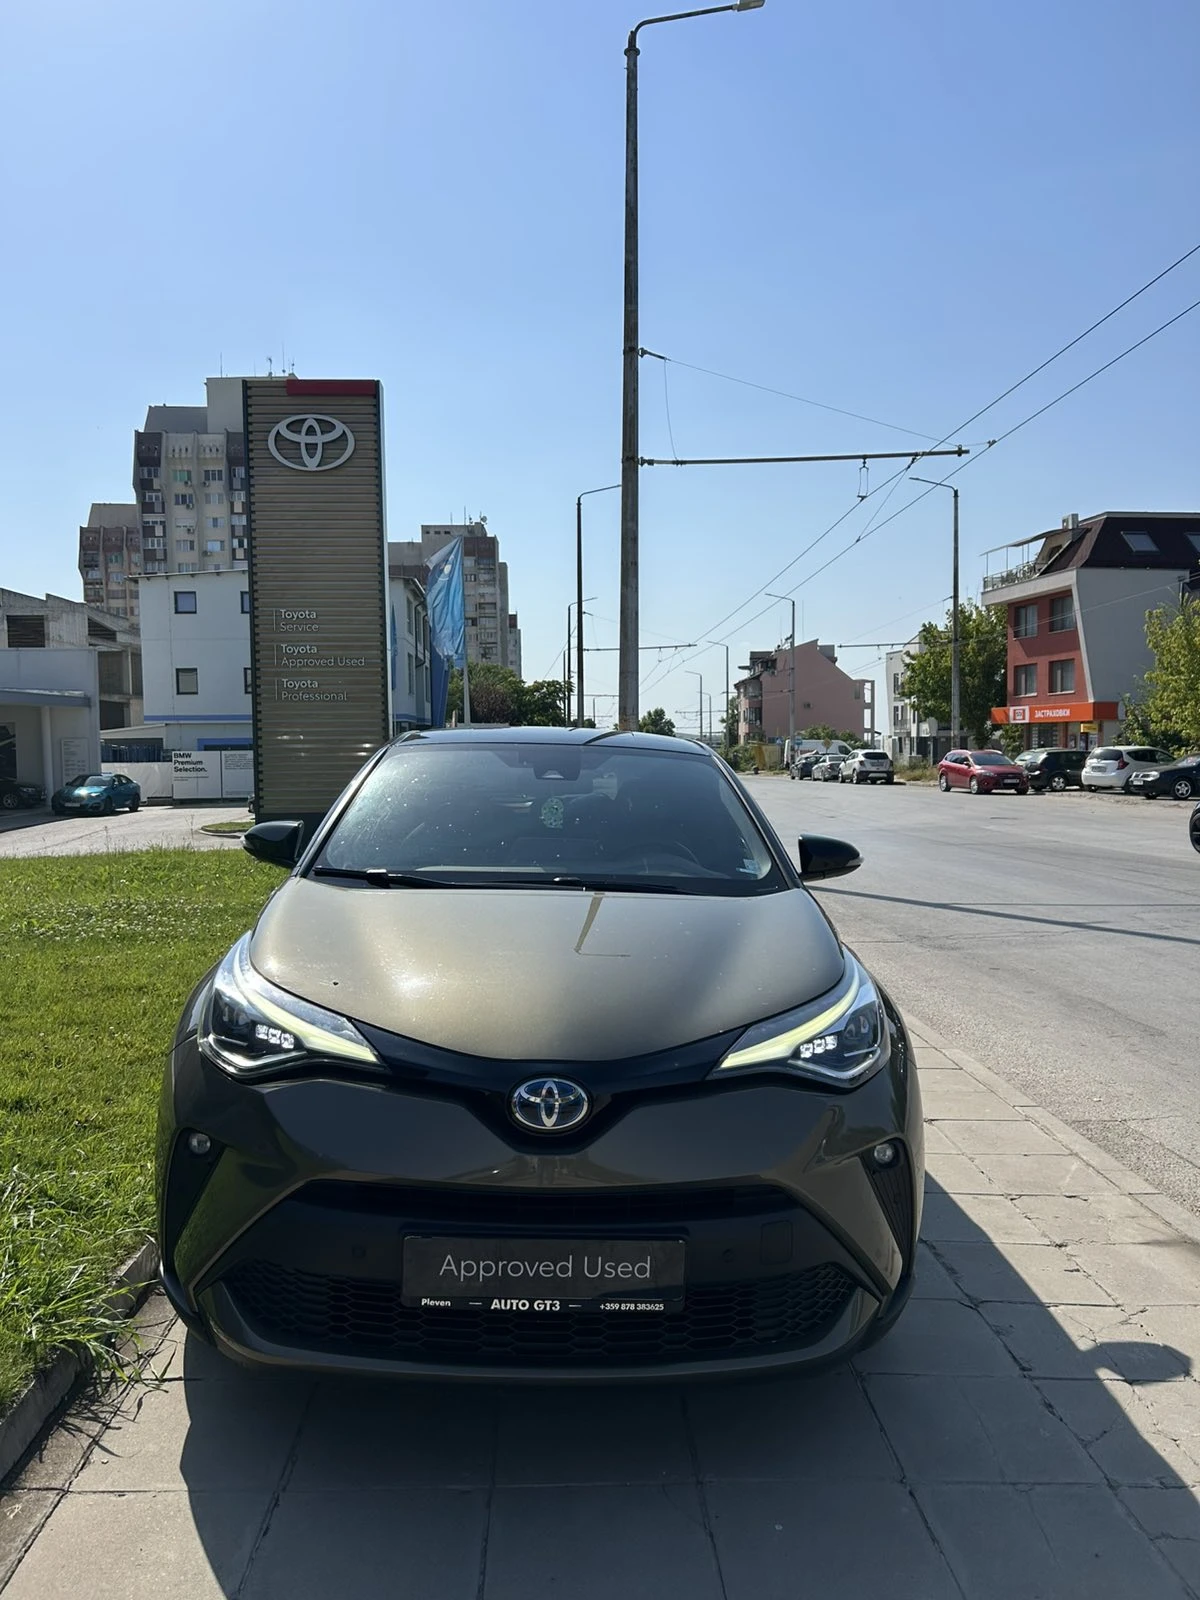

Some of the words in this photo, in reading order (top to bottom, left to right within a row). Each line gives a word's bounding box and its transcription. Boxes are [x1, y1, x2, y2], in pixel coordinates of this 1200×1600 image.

[280, 609, 317, 621] Toyota
[280, 621, 319, 632] Service
[281, 644, 317, 655] Toyota
[281, 656, 334, 668] Approved
[338, 656, 365, 666] Used
[282, 678, 318, 690] Toyota
[281, 691, 347, 701] Professional
[1034, 708, 1071, 719] ЗАСТРАХОВКИ
[439, 1254, 573, 1282] Approved
[584, 1255, 651, 1278] Used
[421, 1298, 451, 1307] Pleven
[490, 1299, 529, 1311] AUTO
[533, 1299, 561, 1311] GT3
[599, 1303, 620, 1311] +359
[620, 1303, 635, 1311] 878
[635, 1303, 665, 1311] 383625
